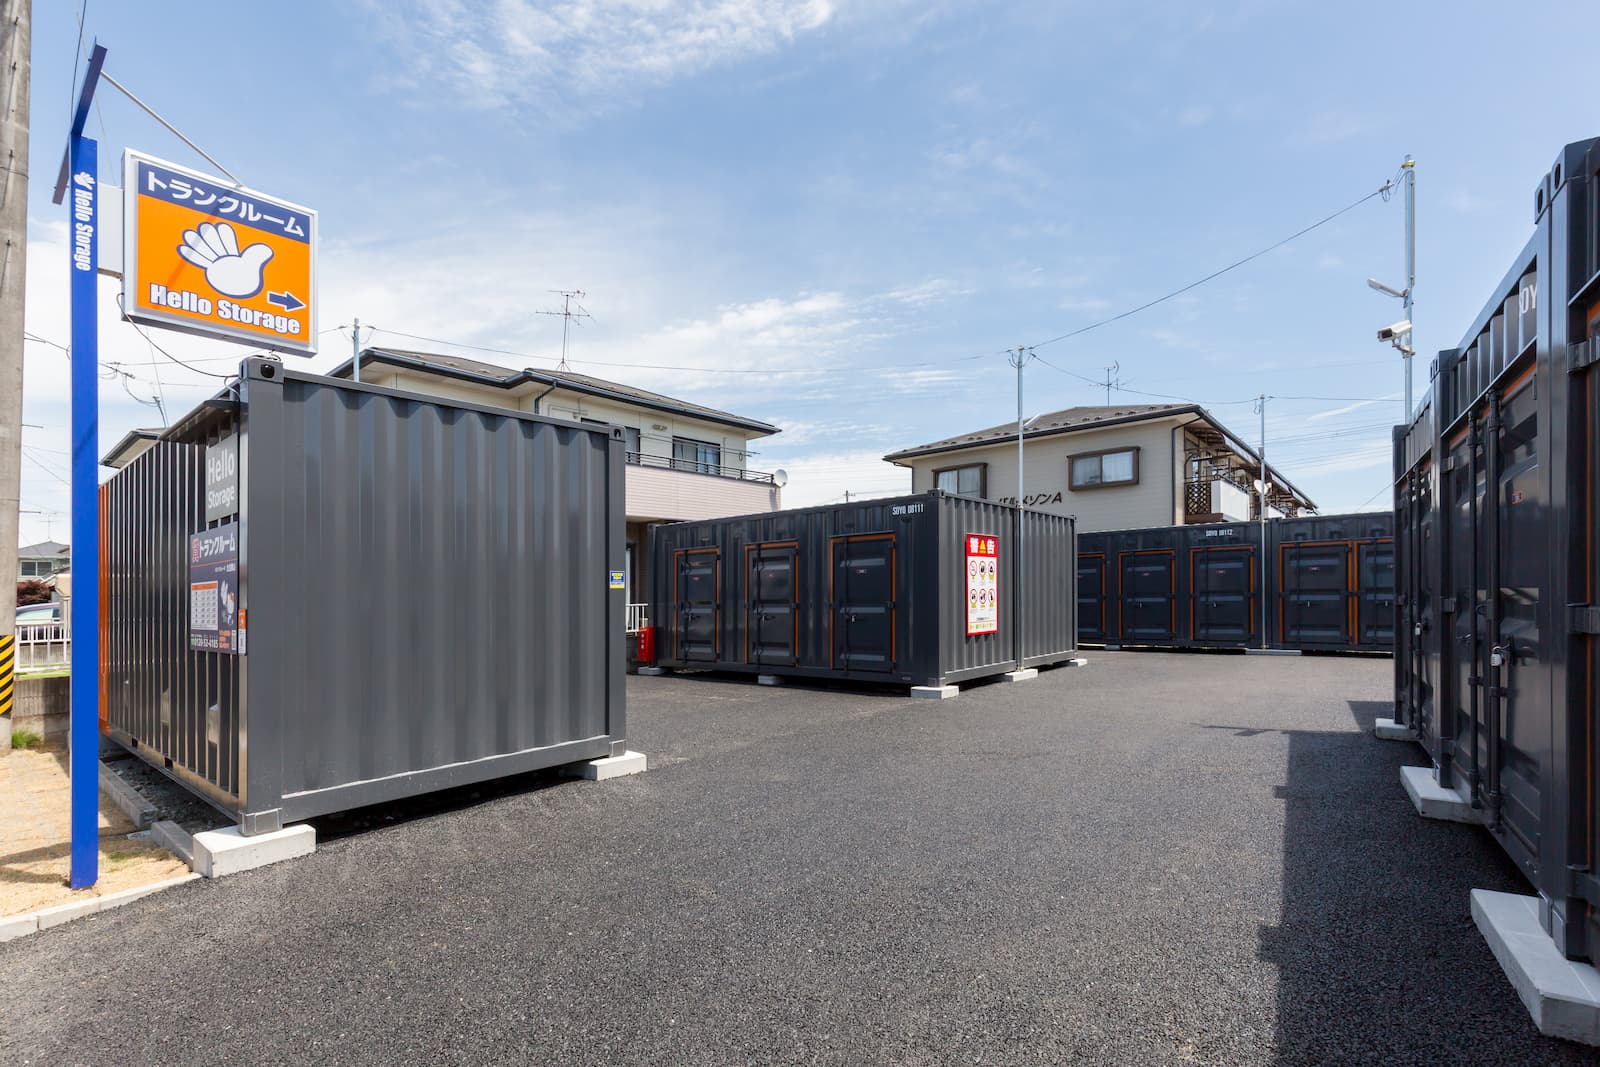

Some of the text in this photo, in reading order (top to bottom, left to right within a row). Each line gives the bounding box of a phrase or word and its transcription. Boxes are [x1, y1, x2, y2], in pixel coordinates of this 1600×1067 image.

[147, 171, 305, 237] トランクルーム
[73, 188, 94, 272] Hello Storage
[149, 282, 301, 335] Hello Storage
[208, 448, 235, 486] Hello
[208, 486, 235, 509] Storage
[199, 531, 236, 559] トランクルーム
